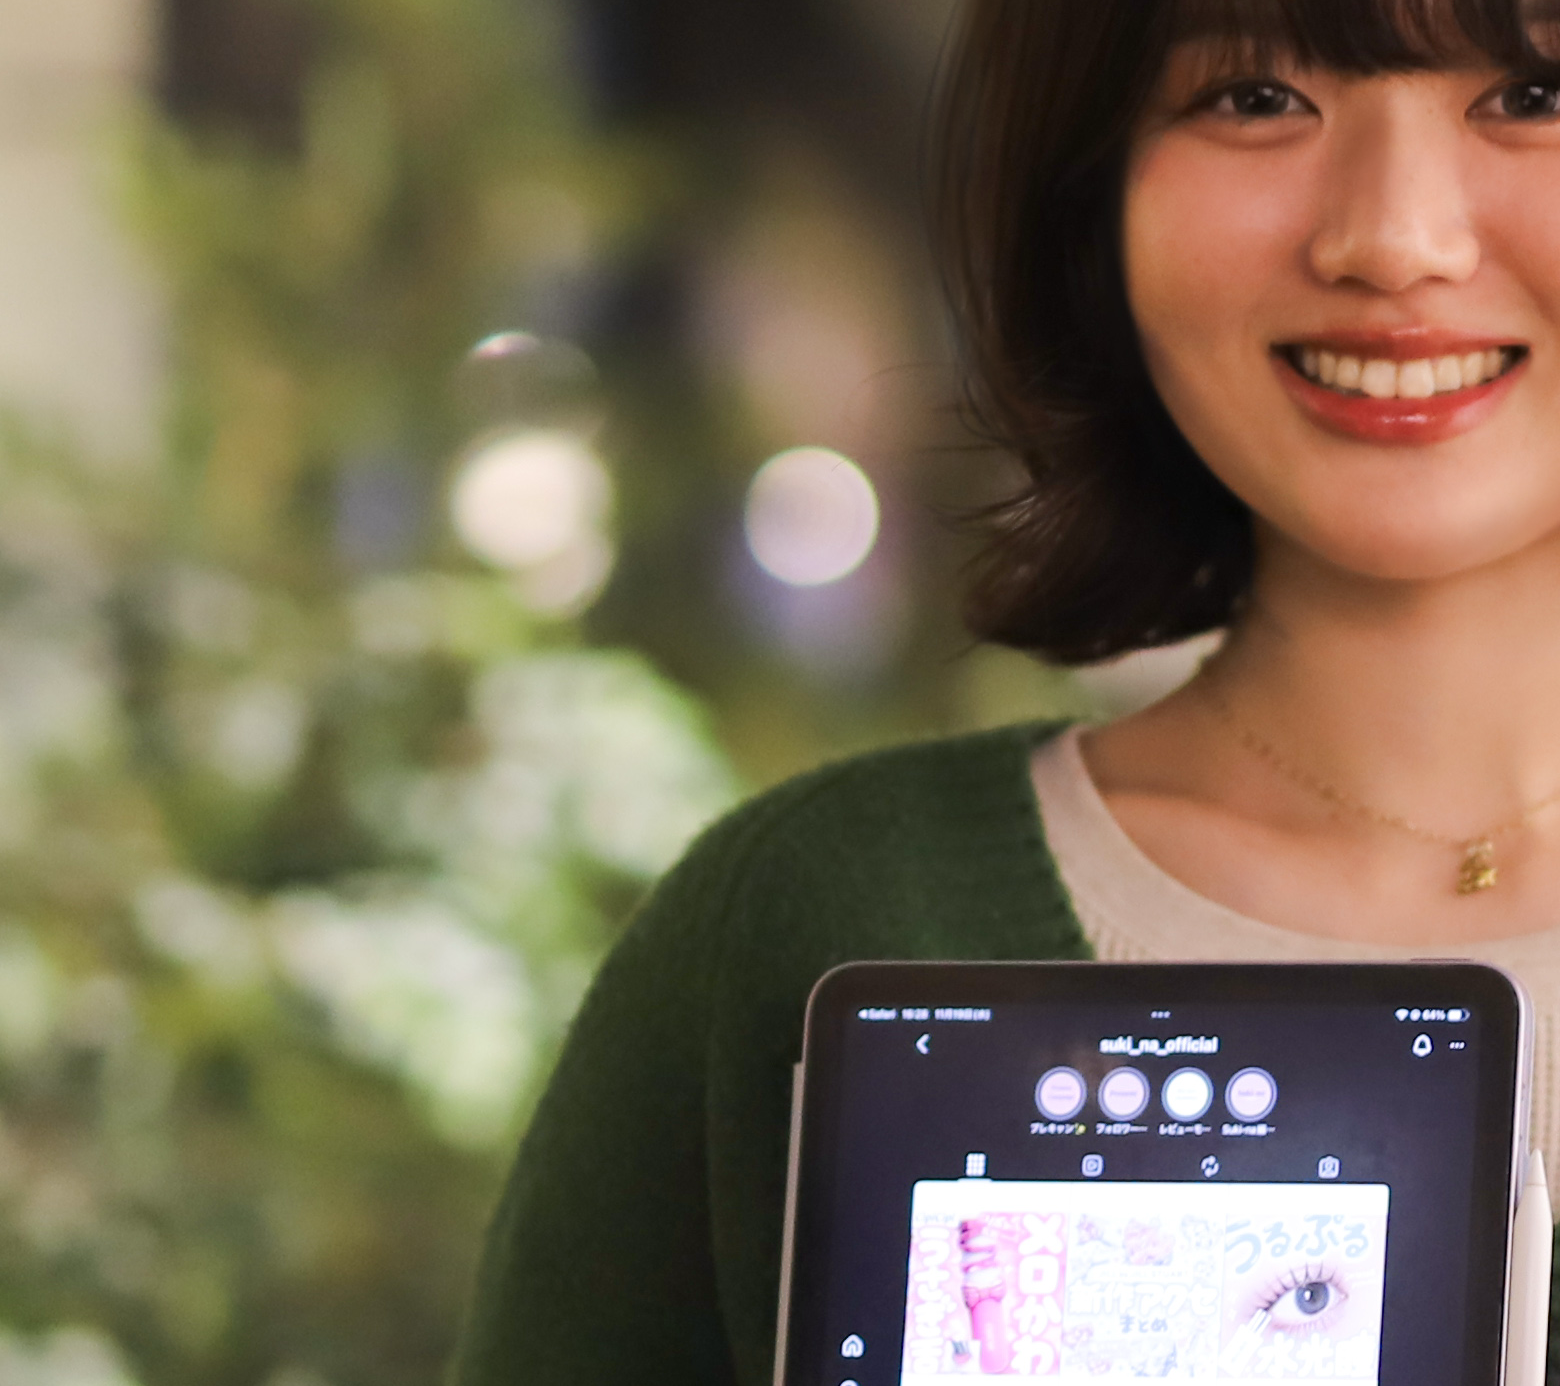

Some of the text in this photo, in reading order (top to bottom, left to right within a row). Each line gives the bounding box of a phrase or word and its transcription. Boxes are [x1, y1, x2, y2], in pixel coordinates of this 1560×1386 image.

[1098, 1035, 1220, 1057] suki_na_official
[1224, 1213, 1370, 1275] うるぷる
[1010, 1213, 1064, 1375] メロかわ
[1068, 1280, 1219, 1317] 新作アクセ
[1118, 1313, 1169, 1334] まとめ
